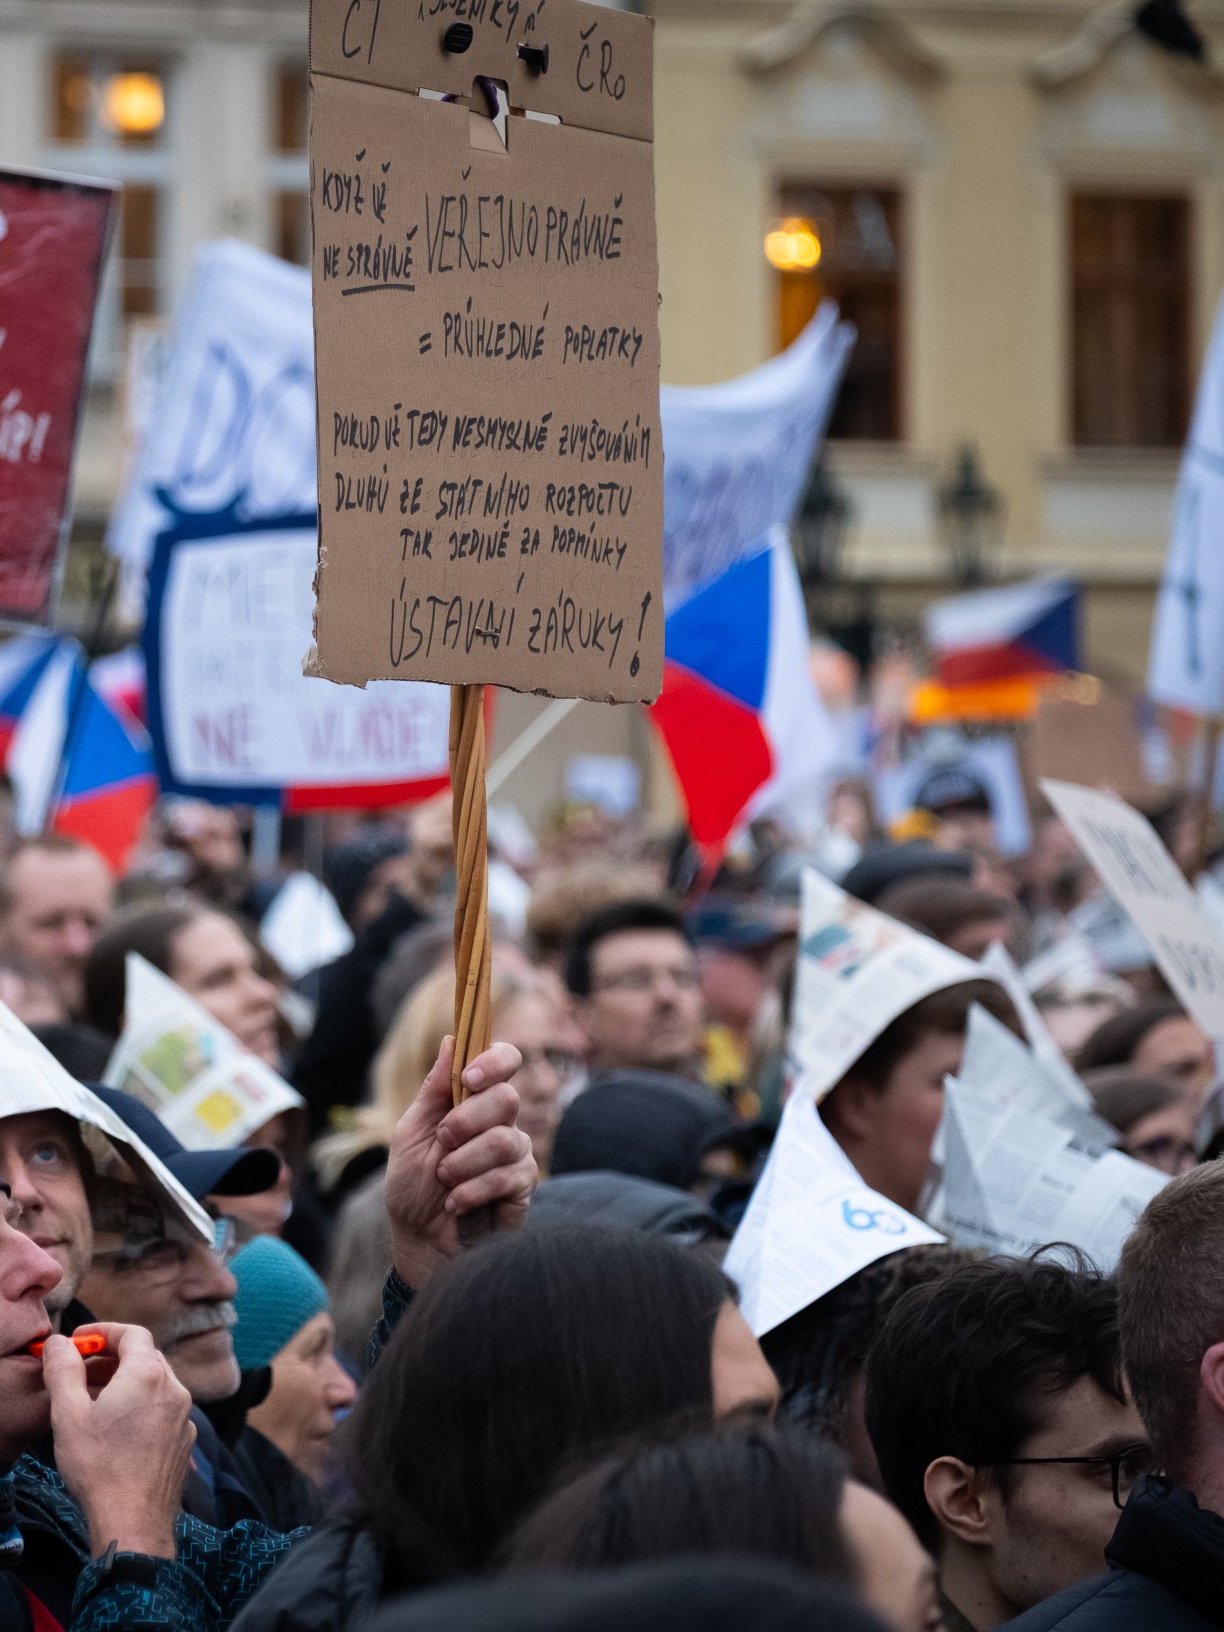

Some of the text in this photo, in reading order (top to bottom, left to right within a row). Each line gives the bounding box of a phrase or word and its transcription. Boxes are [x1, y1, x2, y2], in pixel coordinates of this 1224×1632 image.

[323, 148, 367, 215] KDYŽ
[564, 324, 643, 367] POPLATKY
[334, 411, 380, 457] POKUD
[407, 409, 448, 453] TEDY
[400, 477, 423, 515] ZE
[400, 528, 433, 561] TAK
[520, 527, 540, 556] ZA
